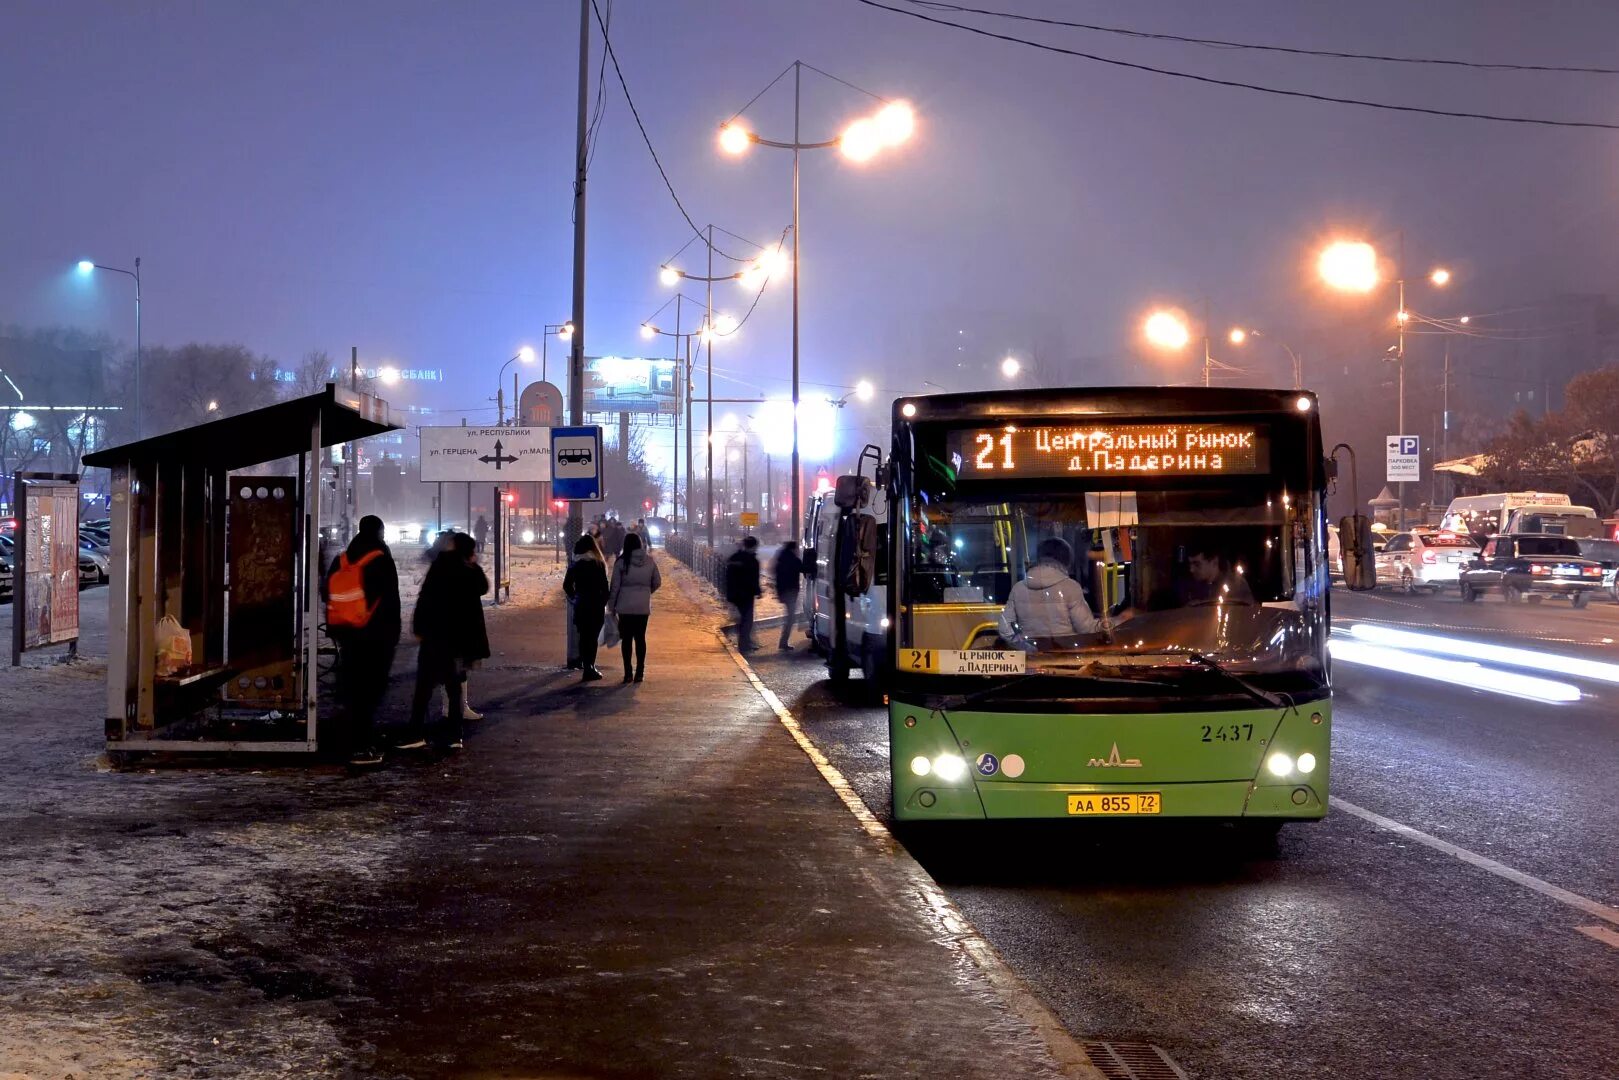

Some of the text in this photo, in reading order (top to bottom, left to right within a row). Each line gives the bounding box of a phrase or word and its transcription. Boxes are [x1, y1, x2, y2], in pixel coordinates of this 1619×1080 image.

[467, 430, 478, 438] ул.
[1035, 429, 1254, 452] Центральный рынок
[430, 448, 478, 457] ул. ГЕРЦЕНА
[975, 433, 1015, 469] 21
[911, 650, 931, 669] 21
[970, 652, 1005, 660] РЫНОК
[1201, 724, 1254, 742] 2437
[1101, 797, 1130, 812] 855
[1139, 796, 1154, 807] 72
